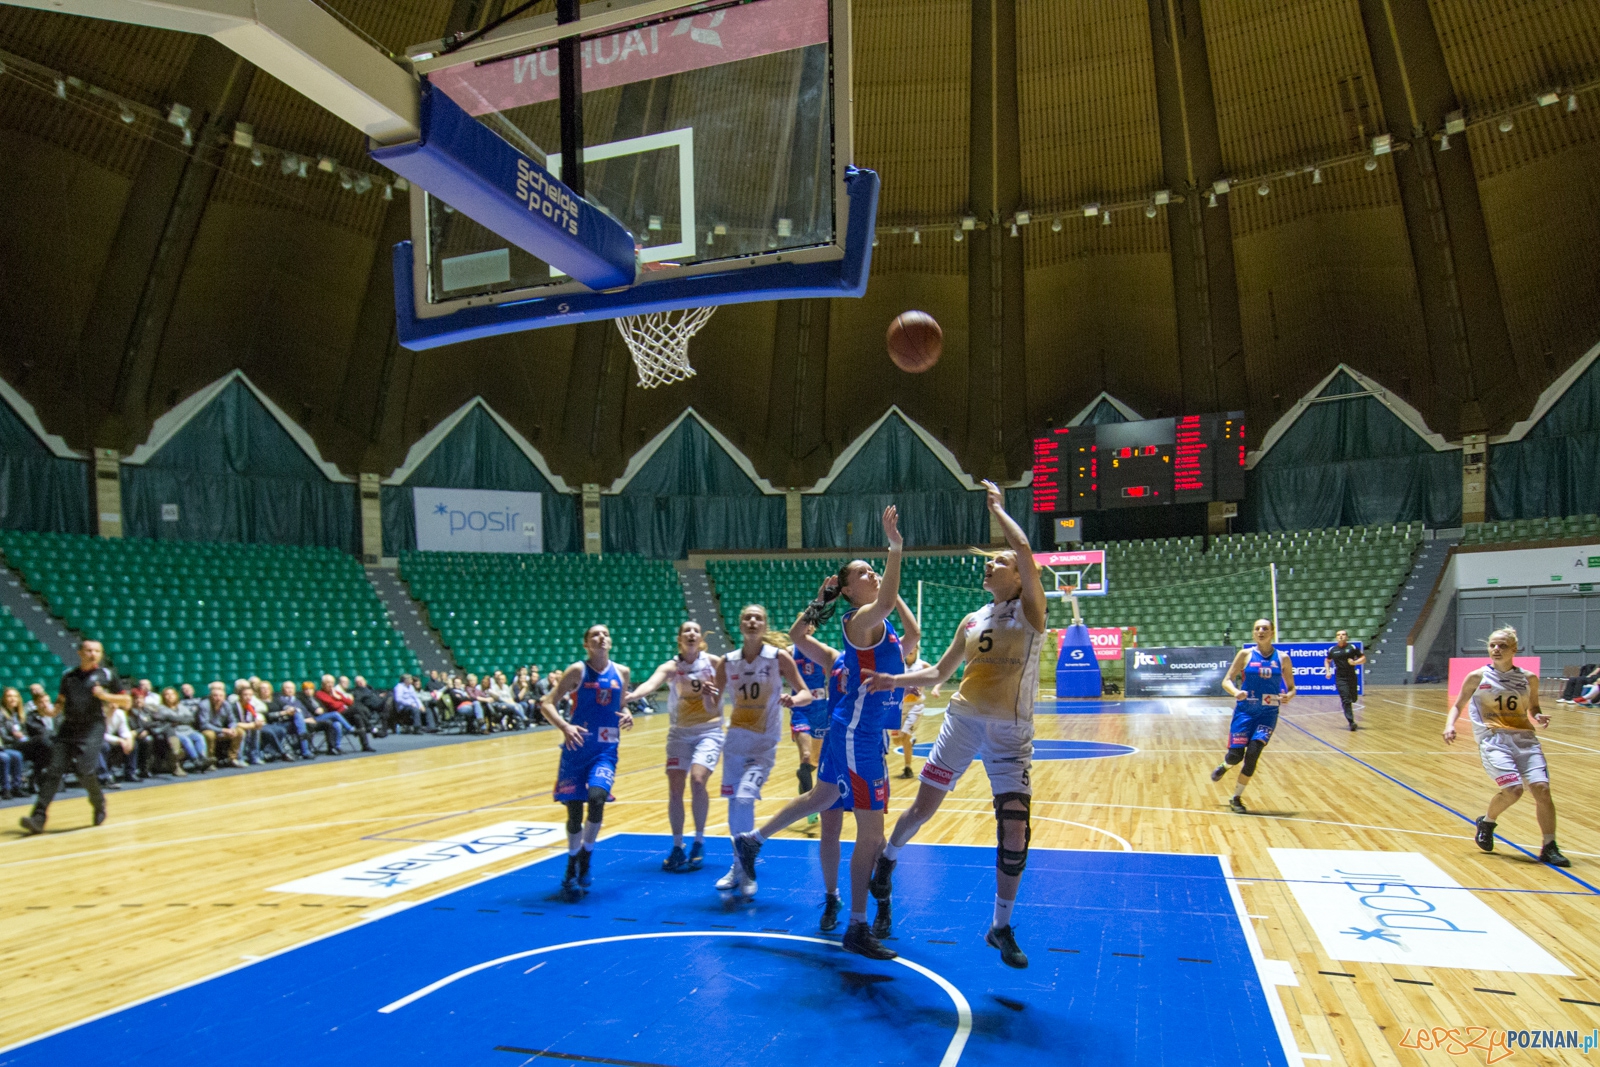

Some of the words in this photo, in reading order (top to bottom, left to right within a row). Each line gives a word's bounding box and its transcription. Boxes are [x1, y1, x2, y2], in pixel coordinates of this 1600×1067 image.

[517, 158, 579, 218] Schelde
[516, 179, 578, 235] Sports
[1112, 459, 1119, 468] 5
[1162, 455, 1170, 464] 4
[450, 506, 520, 535] posir
[1059, 554, 1087, 562] TAURON
[1574, 558, 1584, 567] A
[978, 629, 993, 653] 5
[1290, 649, 1328, 657] internet
[1133, 651, 1156, 669] jtc
[1170, 662, 1218, 670] outsourcing
[1220, 660, 1227, 668] IT
[691, 680, 701, 692] 9
[739, 682, 760, 700] 10
[1321, 684, 1337, 692] swoj
[1494, 695, 1519, 711] 16
[706, 755, 714, 763] 9
[749, 772, 764, 787] 10
[1021, 769, 1029, 787] 5
